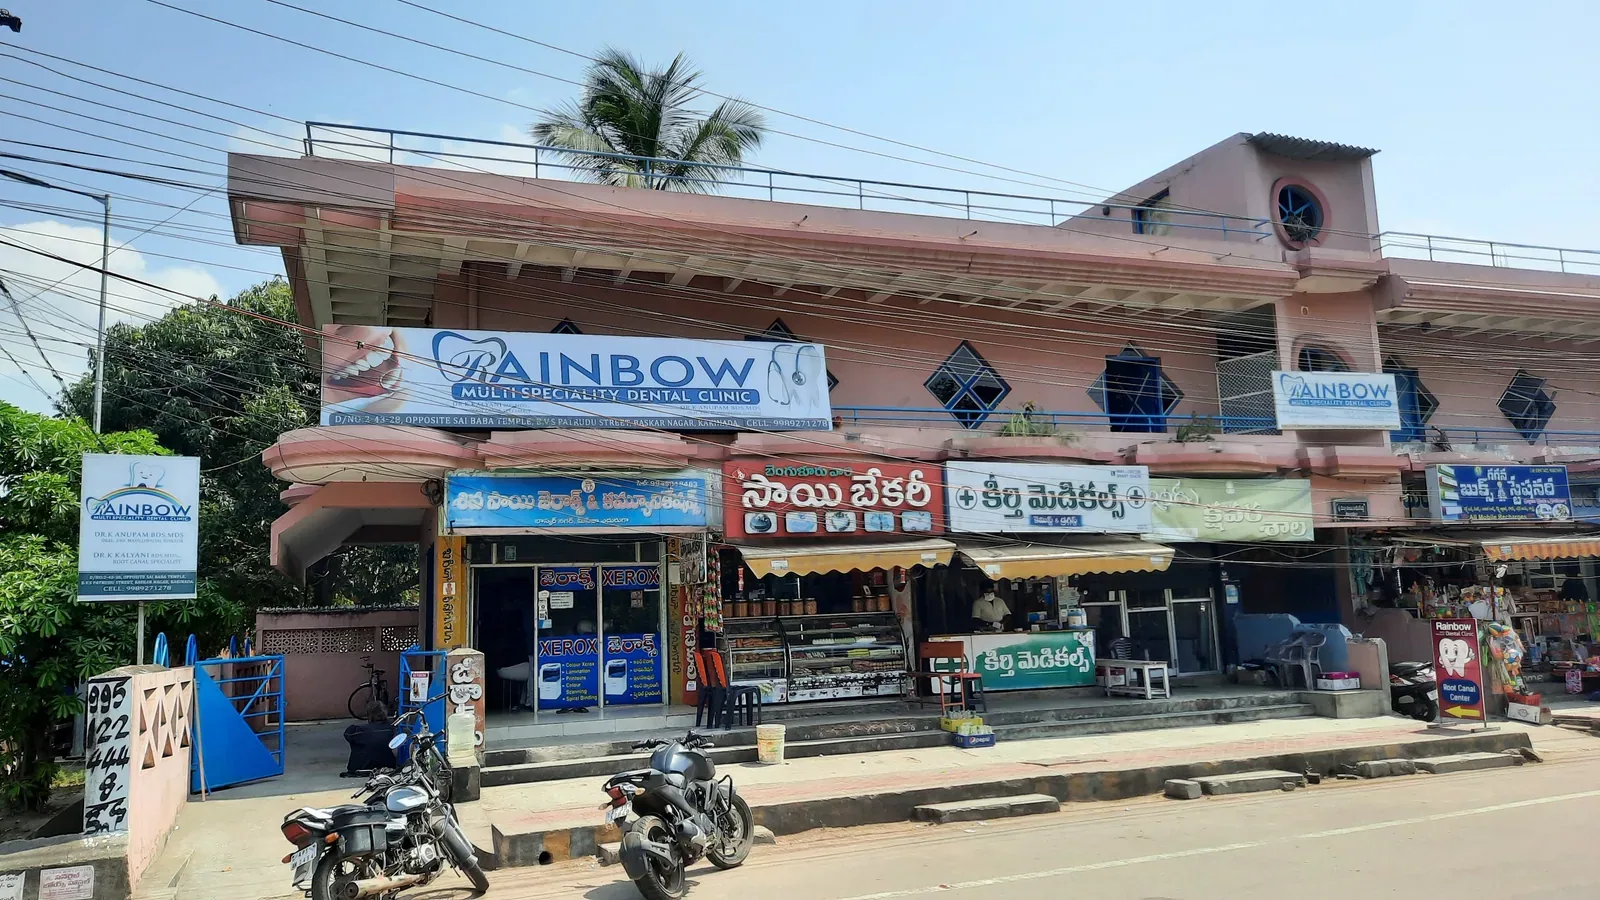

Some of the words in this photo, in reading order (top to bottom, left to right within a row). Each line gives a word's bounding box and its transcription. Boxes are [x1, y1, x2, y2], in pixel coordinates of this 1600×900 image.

[450, 349, 755, 388] RAINBOW
[461, 386, 516, 399] MULTI
[521, 386, 620, 402] SPECIALITY
[627, 389, 691, 402] DENTAL
[698, 390, 751, 402] CLINIC
[1289, 382, 1389, 399] RAINBOW
[406, 416, 450, 425] OPPOSITE
[453, 417, 468, 426] SAI
[470, 417, 494, 426] BABA
[633, 419, 666, 428] BASKAR
[667, 419, 696, 428] NAGAR,
[773, 419, 828, 428] 9989271278
[741, 473, 843, 508] సాయి
[850, 468, 932, 507] బేకరీ
[1460, 478, 1494, 503] బుక్స్
[93, 503, 191, 516] RAINBOW
[488, 491, 535, 510] సాయి
[587, 494, 600, 510] &
[1027, 481, 1125, 520] మెడికల్స్
[602, 568, 660, 586] XEROX
[1435, 621, 1471, 631] Rainbow
[539, 638, 599, 657] XEROX
[1017, 646, 1090, 673] మెడికల్స్
[1443, 683, 1457, 691] Root
[1457, 685, 1476, 693] Canal
[1449, 693, 1471, 702] Center
[88, 682, 127, 714] 995
[87, 714, 130, 749] 122
[86, 745, 130, 774] 444
